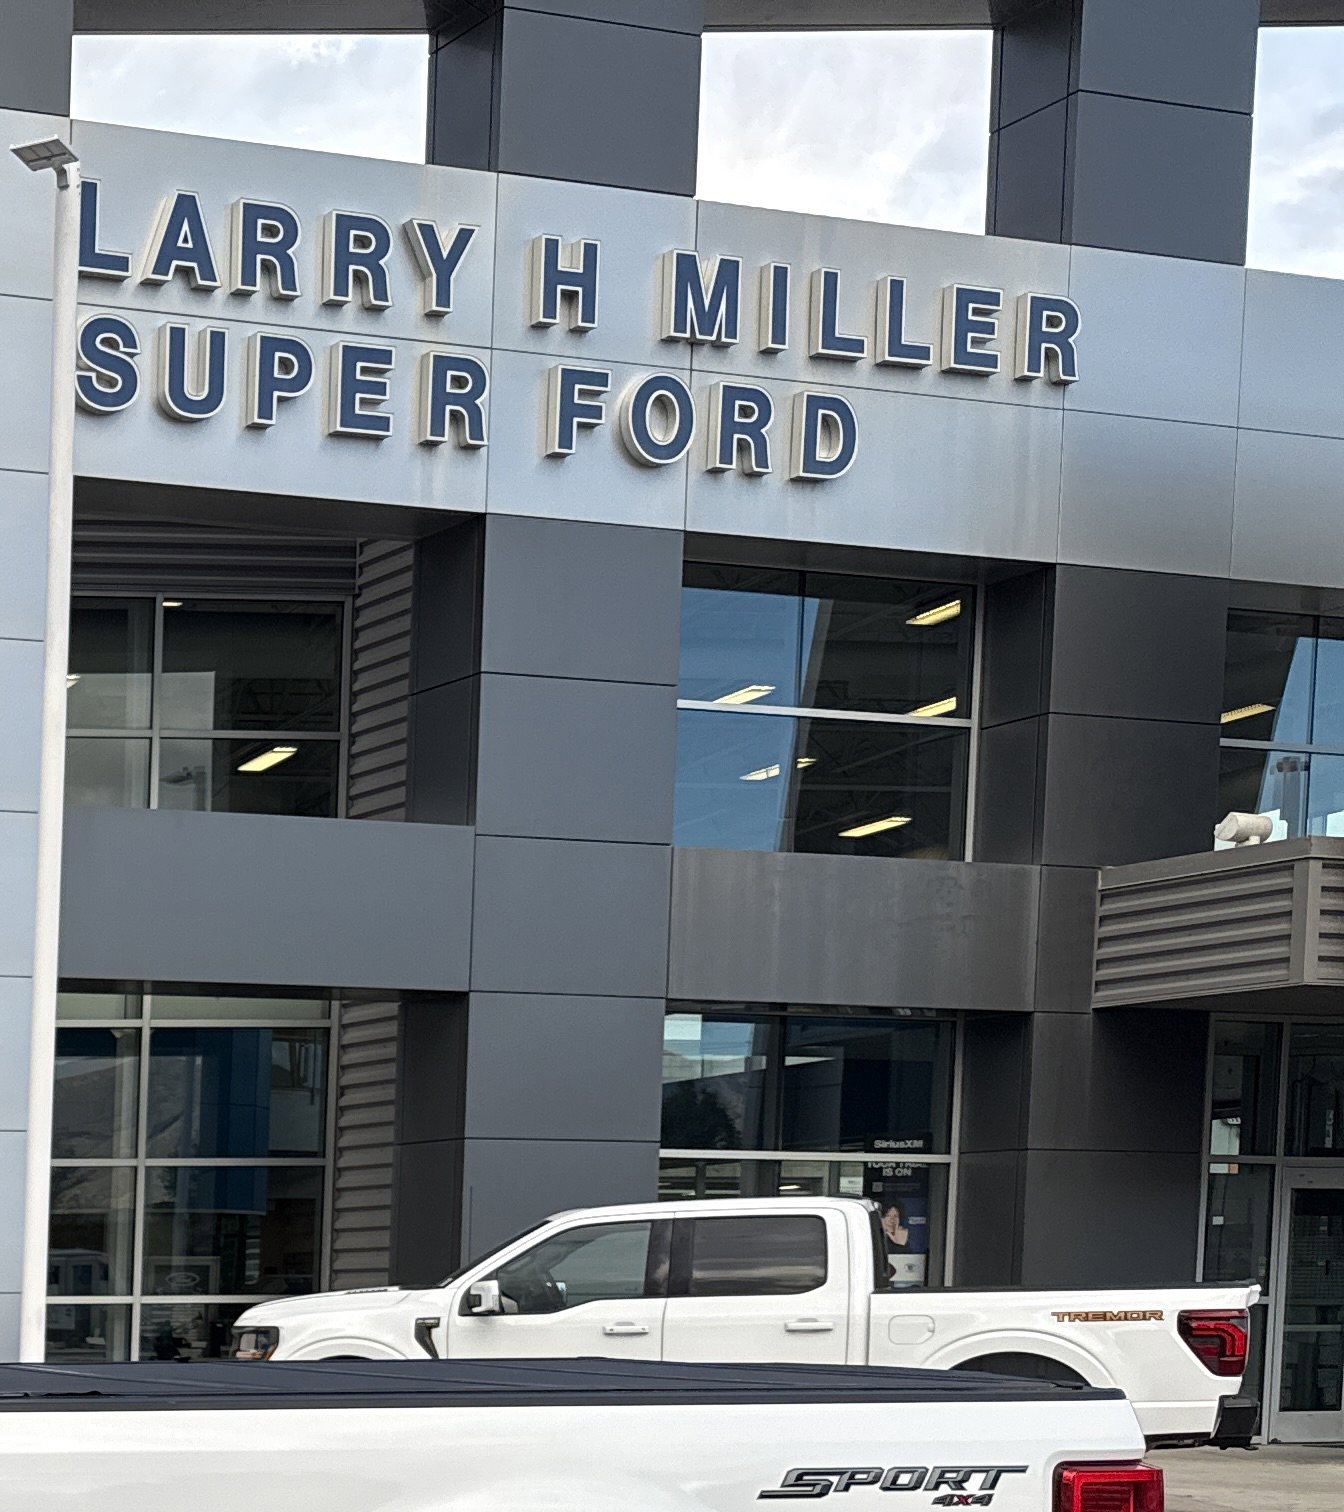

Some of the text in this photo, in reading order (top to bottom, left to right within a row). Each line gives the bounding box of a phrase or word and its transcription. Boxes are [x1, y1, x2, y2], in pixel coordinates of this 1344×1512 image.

[78, 176, 1082, 385] LARRY H MILLER
[75, 313, 859, 481] SUPER FORD
[874, 1140, 923, 1149] SiriusXM
[895, 1168, 912, 1177] ON
[1051, 1310, 1164, 1323] TREMOR
[756, 1465, 1030, 1500] SPORT
